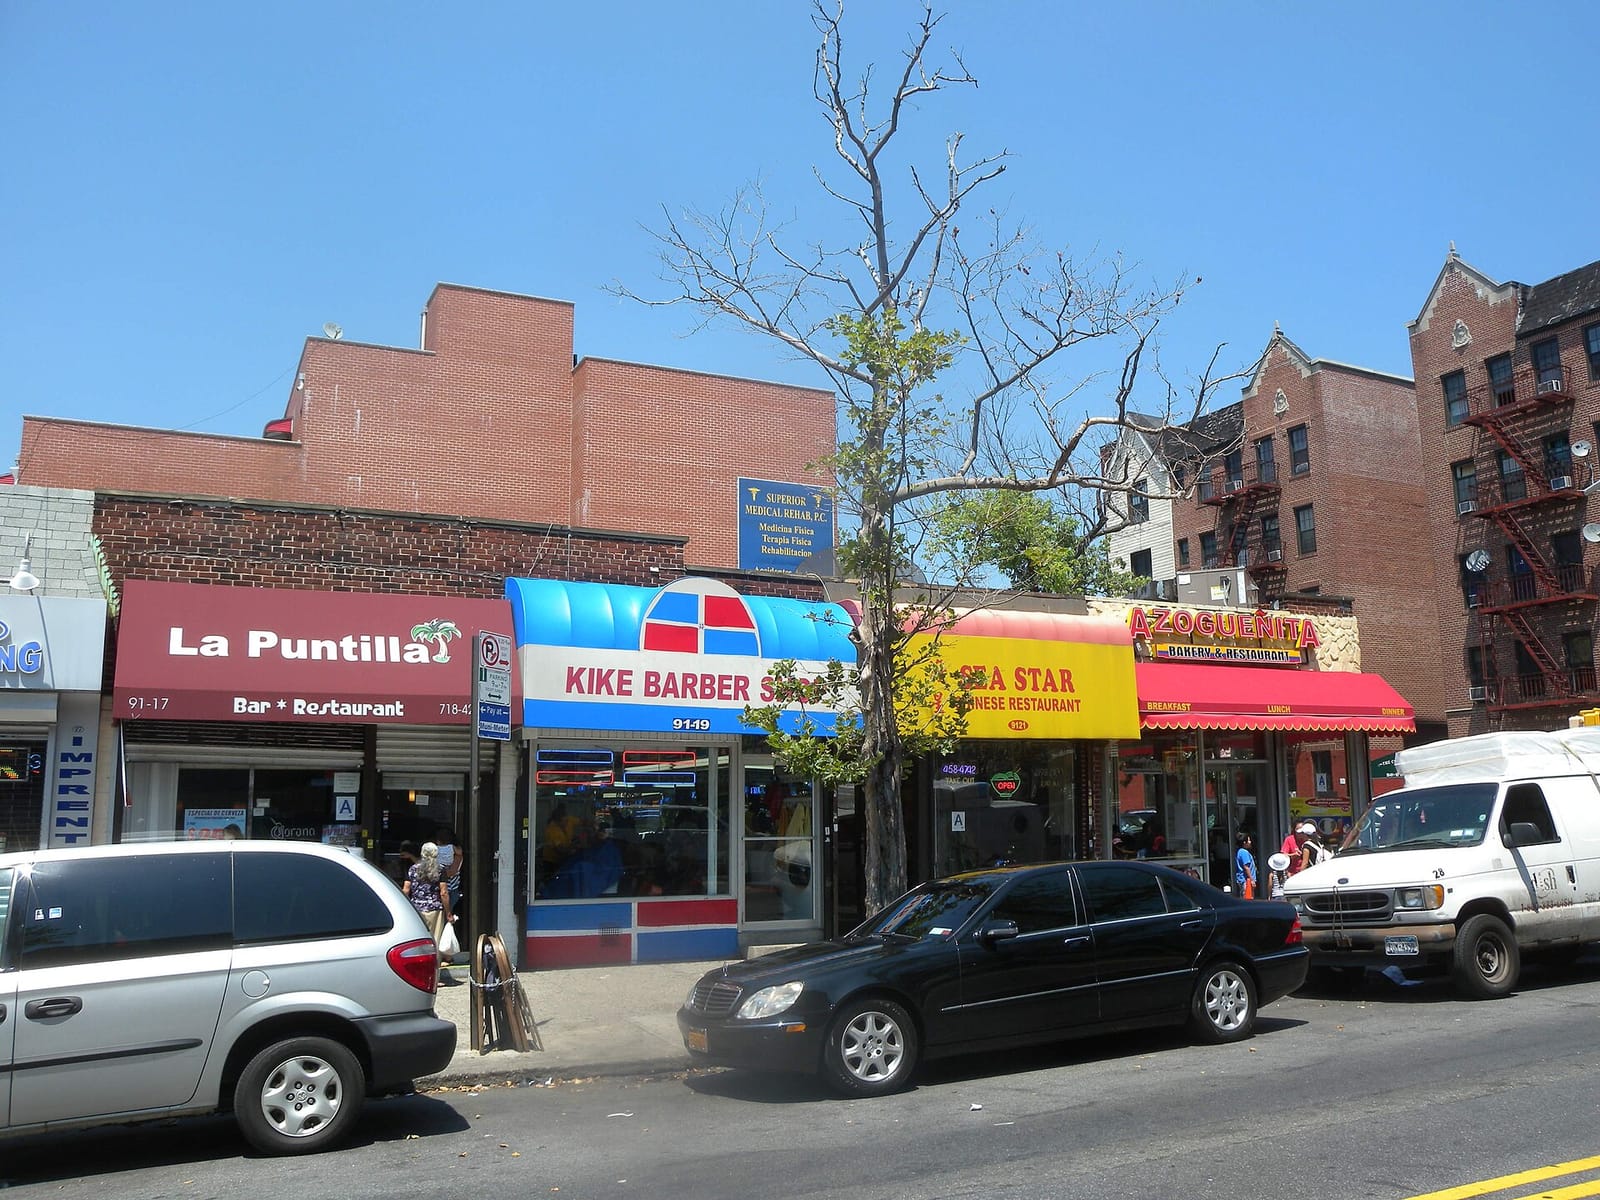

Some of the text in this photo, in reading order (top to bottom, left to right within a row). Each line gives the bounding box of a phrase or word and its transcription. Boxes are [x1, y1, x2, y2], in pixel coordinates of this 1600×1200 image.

[767, 493, 806, 506] SUPERIOR
[745, 505, 783, 517] MEDICAL
[814, 512, 827, 522] P.C.
[759, 523, 792, 533] Medicina
[762, 534, 789, 545] Terapia
[168, 627, 431, 664] La Puntilla
[1168, 645, 1289, 661] BAKERY & RESTAURANT
[565, 666, 633, 696] KIKE
[644, 671, 750, 701] BARBER
[1014, 667, 1075, 693] STAR
[128, 697, 169, 710] 91-17
[233, 697, 404, 716] Bar Restaurant
[955, 696, 1081, 712] INESE RESTAURANT
[1147, 702, 1191, 711] BREAKFAST
[1267, 704, 1291, 713] LUNCH
[487, 705, 496, 716] Pay
[1382, 707, 1405, 716] DINNER
[997, 781, 1015, 790] OPEN
[1319, 775, 1325, 786] A
[339, 799, 352, 814] A
[953, 813, 963, 826] A
[271, 823, 316, 839] Corona
[1432, 868, 1445, 879] 28
